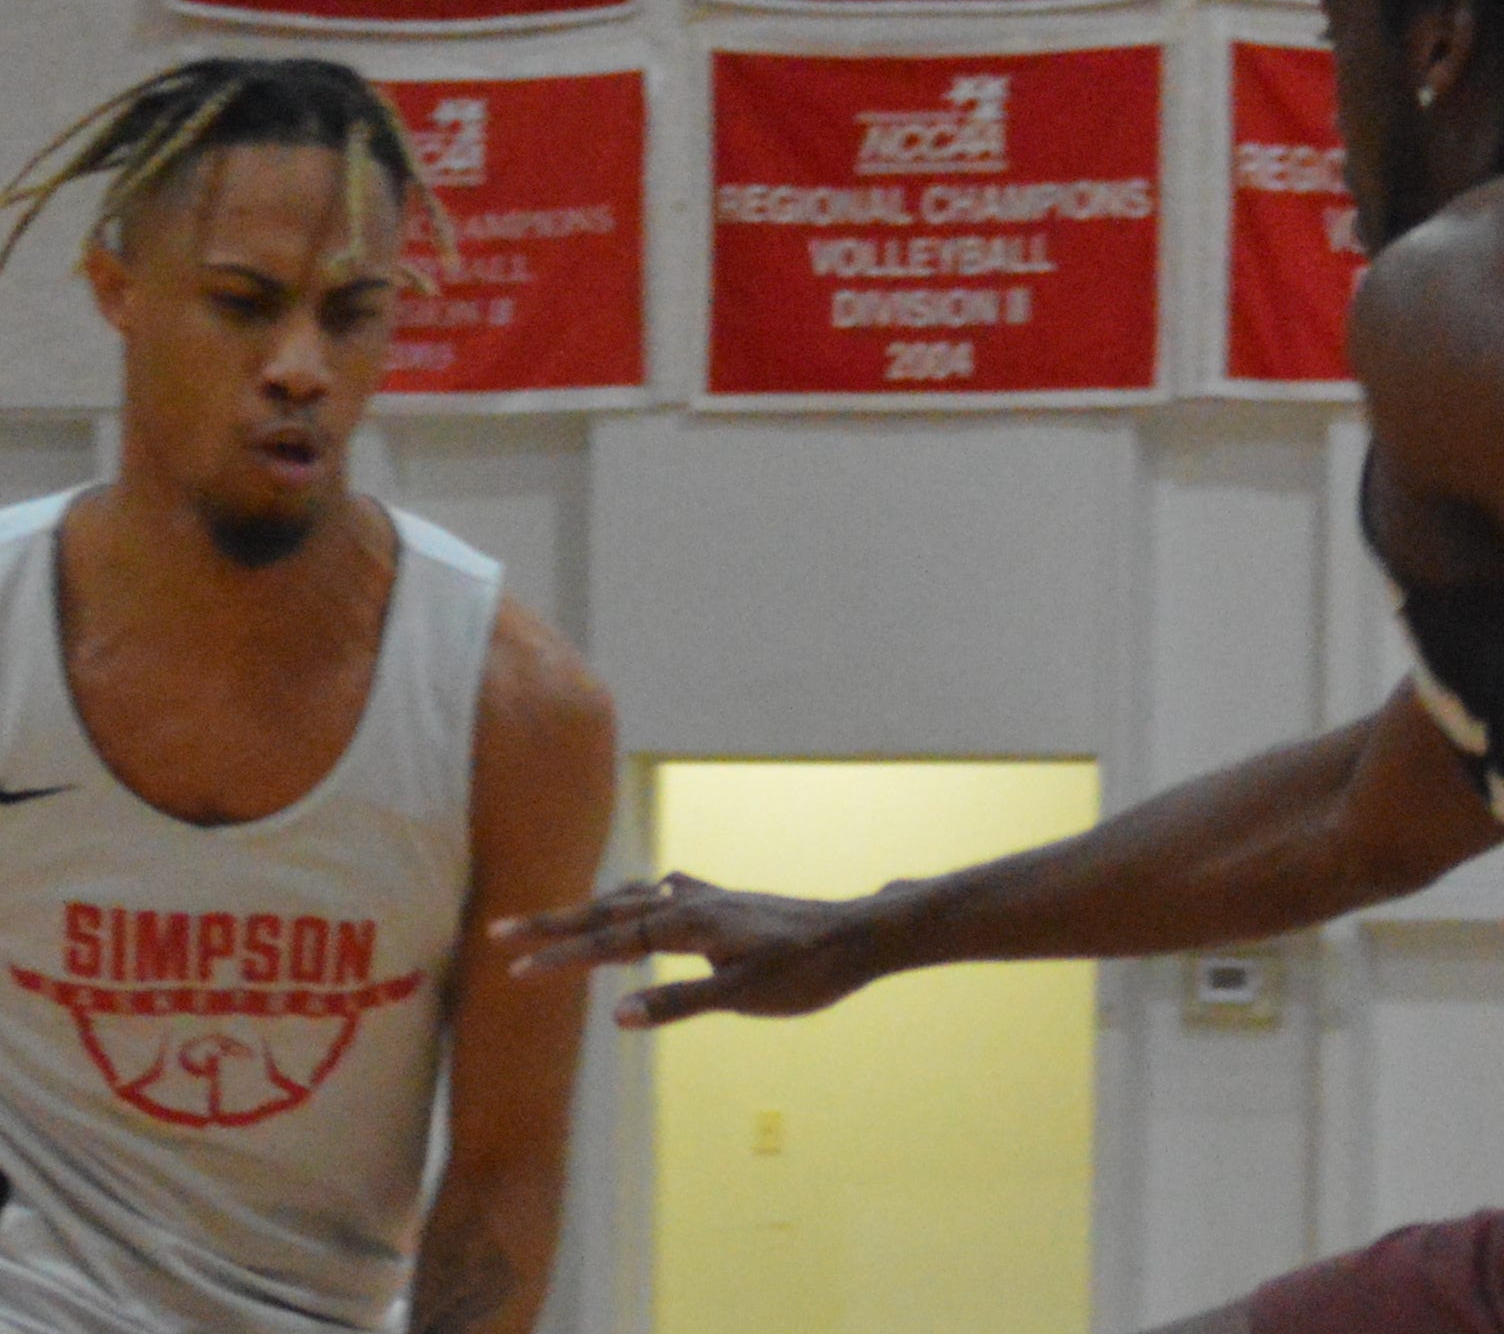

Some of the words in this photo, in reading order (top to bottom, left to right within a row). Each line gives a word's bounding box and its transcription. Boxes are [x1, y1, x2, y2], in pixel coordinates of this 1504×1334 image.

[715, 184, 914, 226] REGIONAL
[921, 179, 1153, 225] CHAMPIONS
[810, 233, 1058, 278] VOLLEYBALL
[832, 287, 1001, 329] DIVISION
[63, 899, 378, 986] SIMPSON
